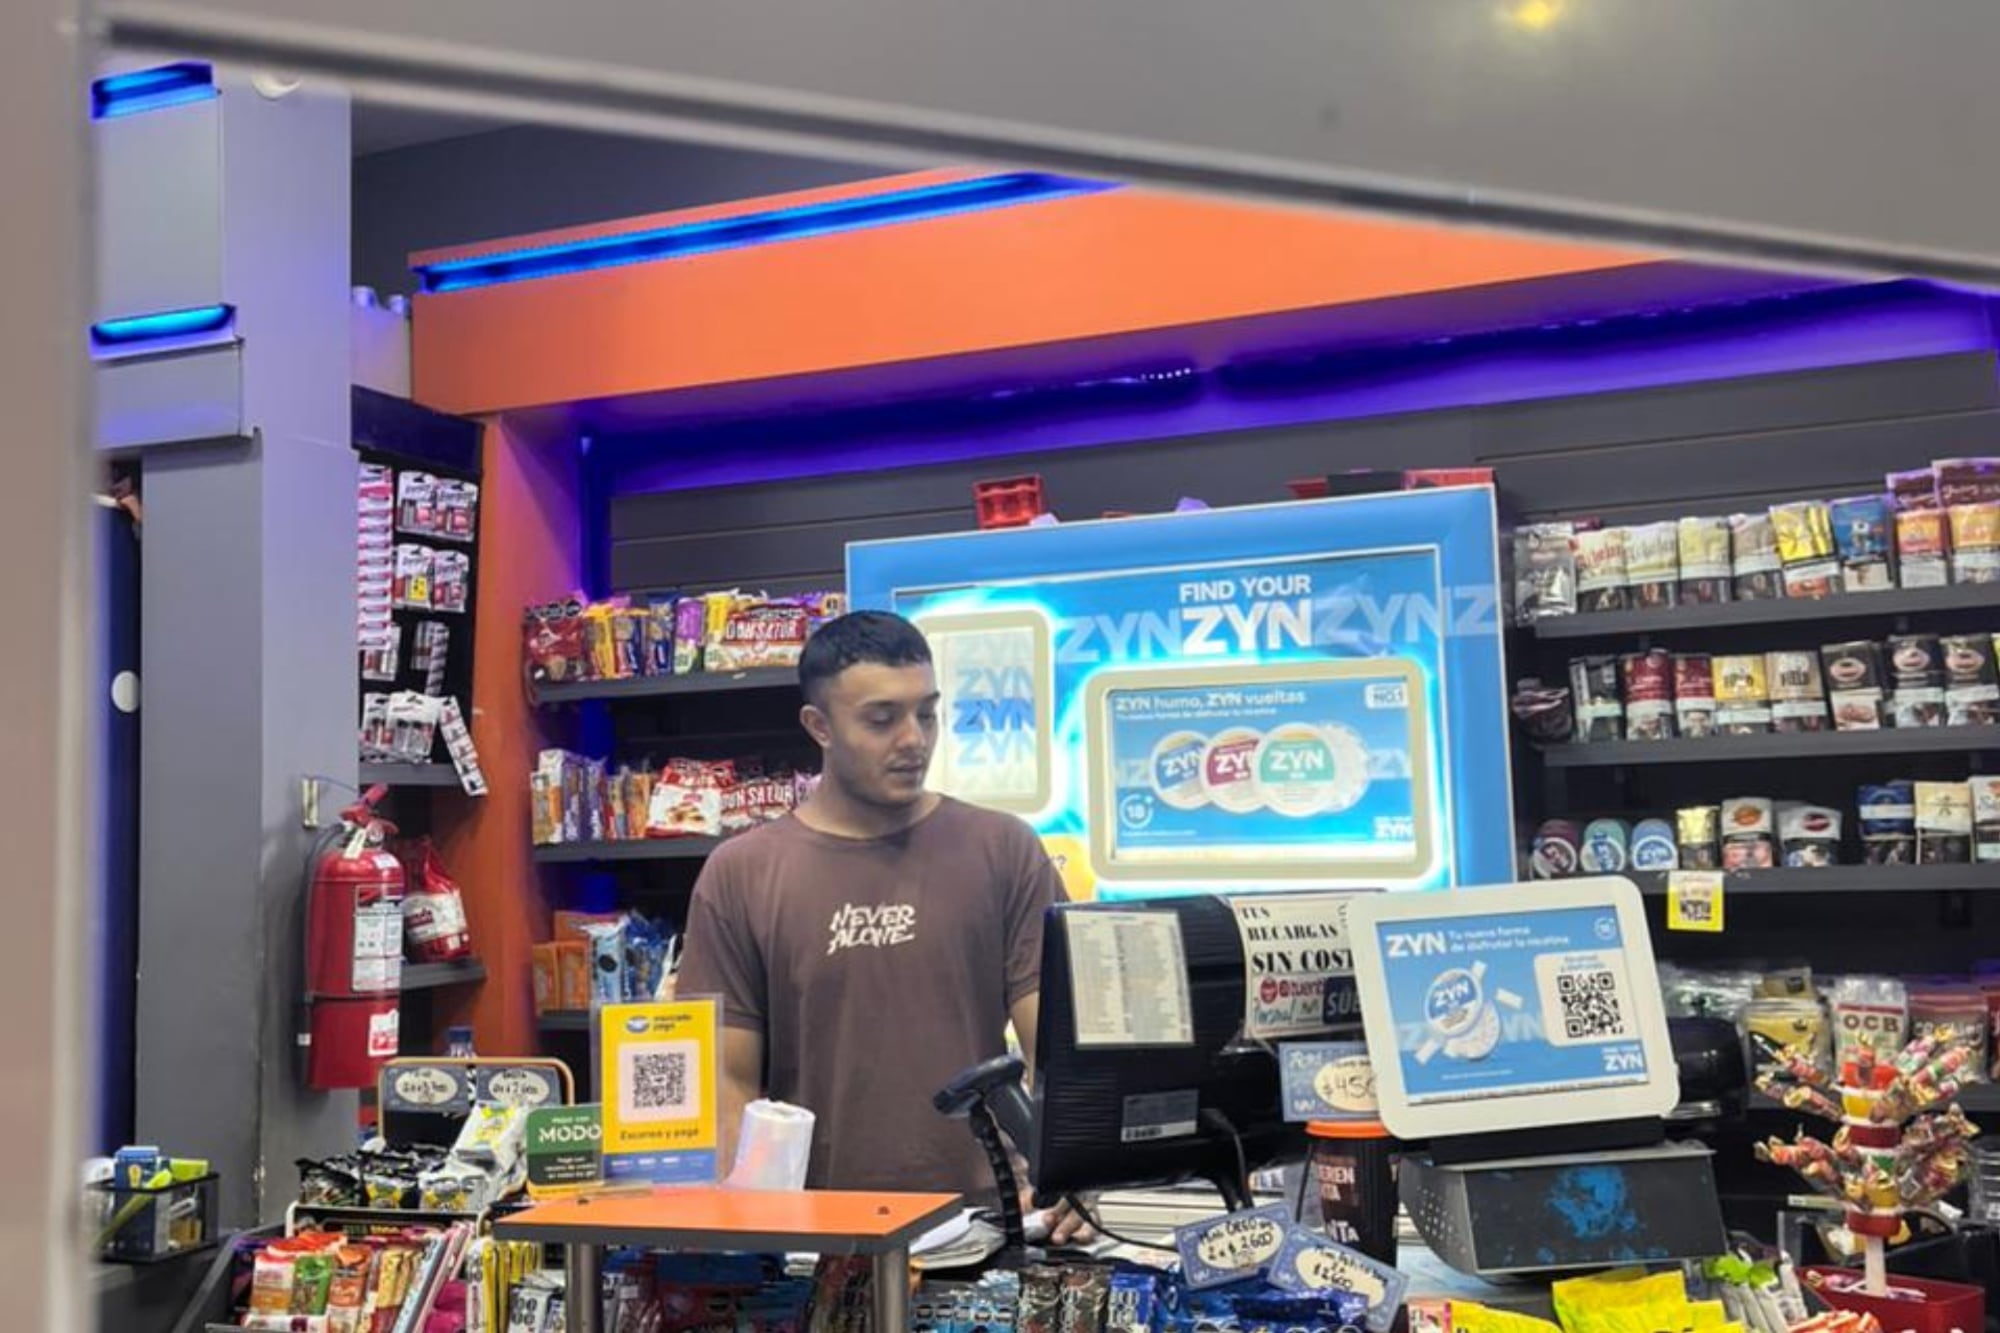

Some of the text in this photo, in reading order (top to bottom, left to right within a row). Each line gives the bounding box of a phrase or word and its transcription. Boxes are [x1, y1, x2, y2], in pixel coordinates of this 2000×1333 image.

[1180, 575, 1312, 602] FIND YOUR
[1058, 608, 1182, 663] ZYN
[1181, 599, 1312, 656] ZYN
[1207, 692, 1242, 707] ZYN
[954, 697, 1035, 734] ZYN
[1270, 749, 1325, 772] ZYN
[829, 902, 916, 931] NEVER
[827, 924, 915, 955] ALONE
[1247, 923, 1339, 941] RECARGAS
[1386, 931, 1446, 957] ZYN
[1252, 951, 1293, 973] SIN
[1844, 1014, 1899, 1032] OCB
[1603, 1053, 1645, 1073] ZYN
[538, 1123, 602, 1144] MODO
